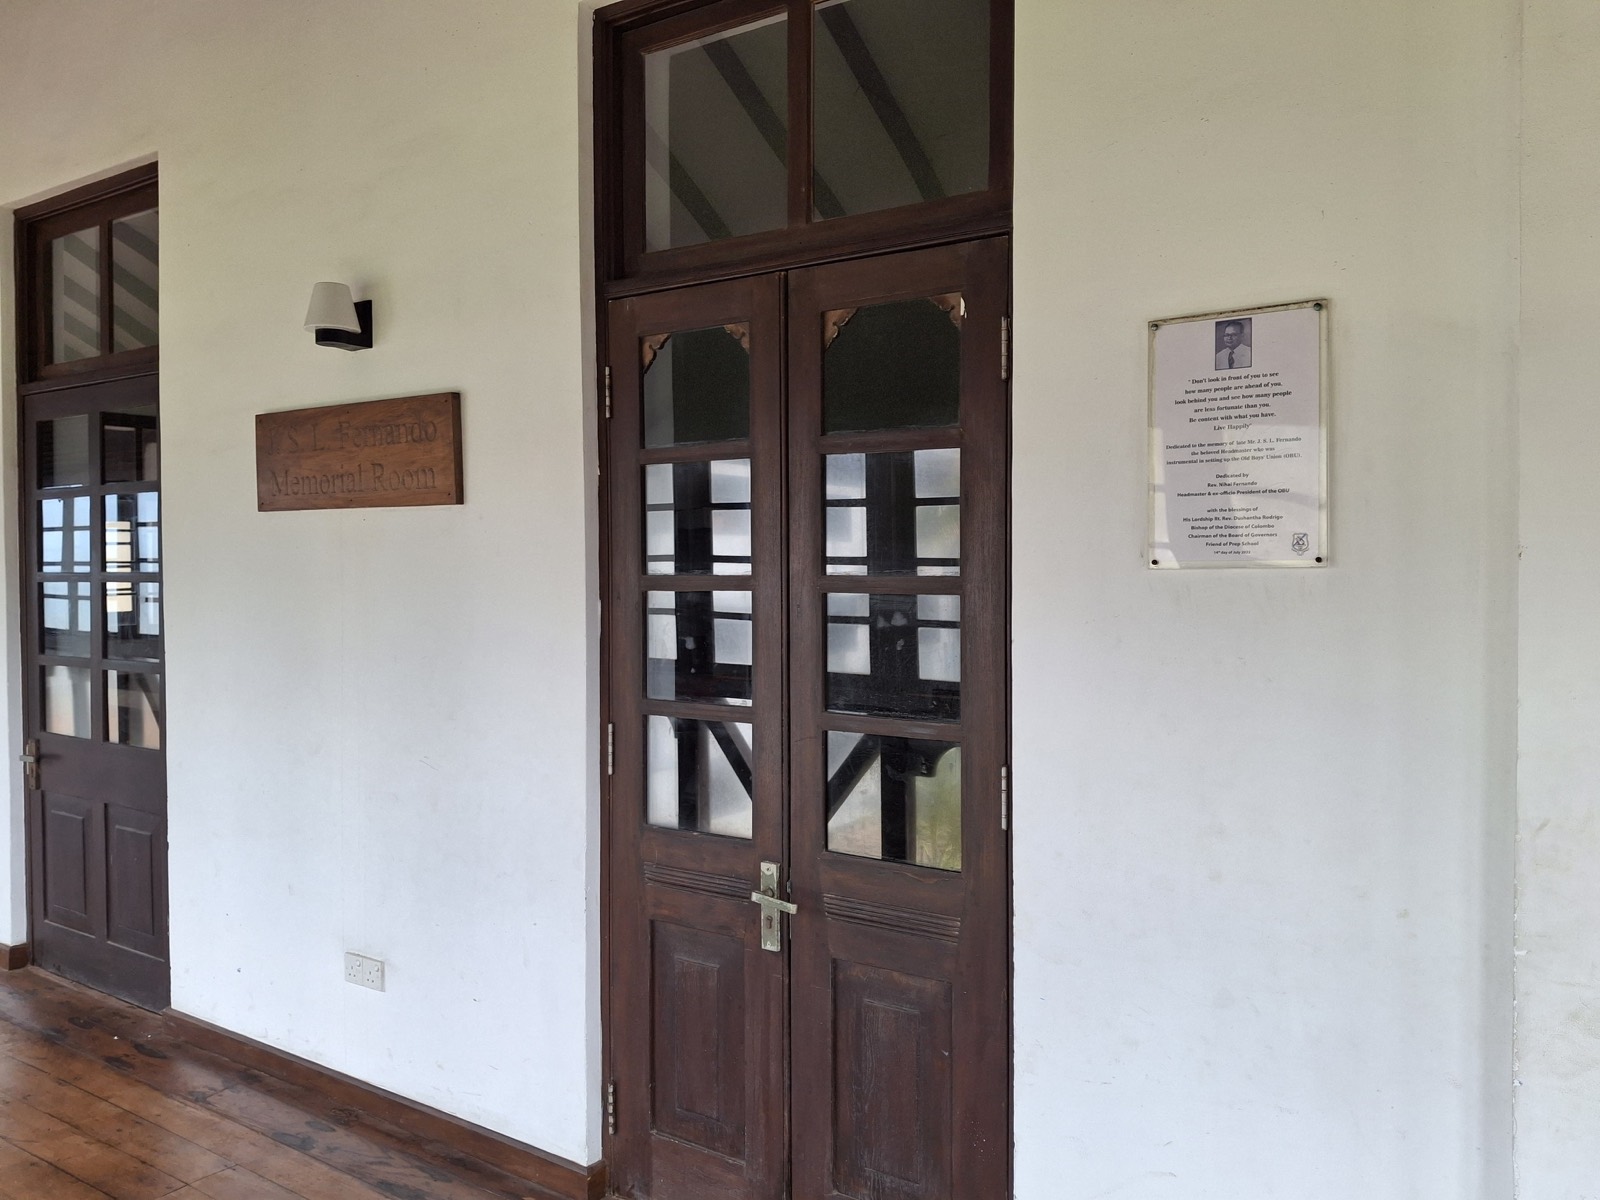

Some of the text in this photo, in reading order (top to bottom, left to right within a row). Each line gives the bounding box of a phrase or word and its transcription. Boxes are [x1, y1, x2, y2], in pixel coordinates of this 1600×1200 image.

[338, 414, 437, 449] Fernando
[269, 463, 437, 497] Memorial Room
